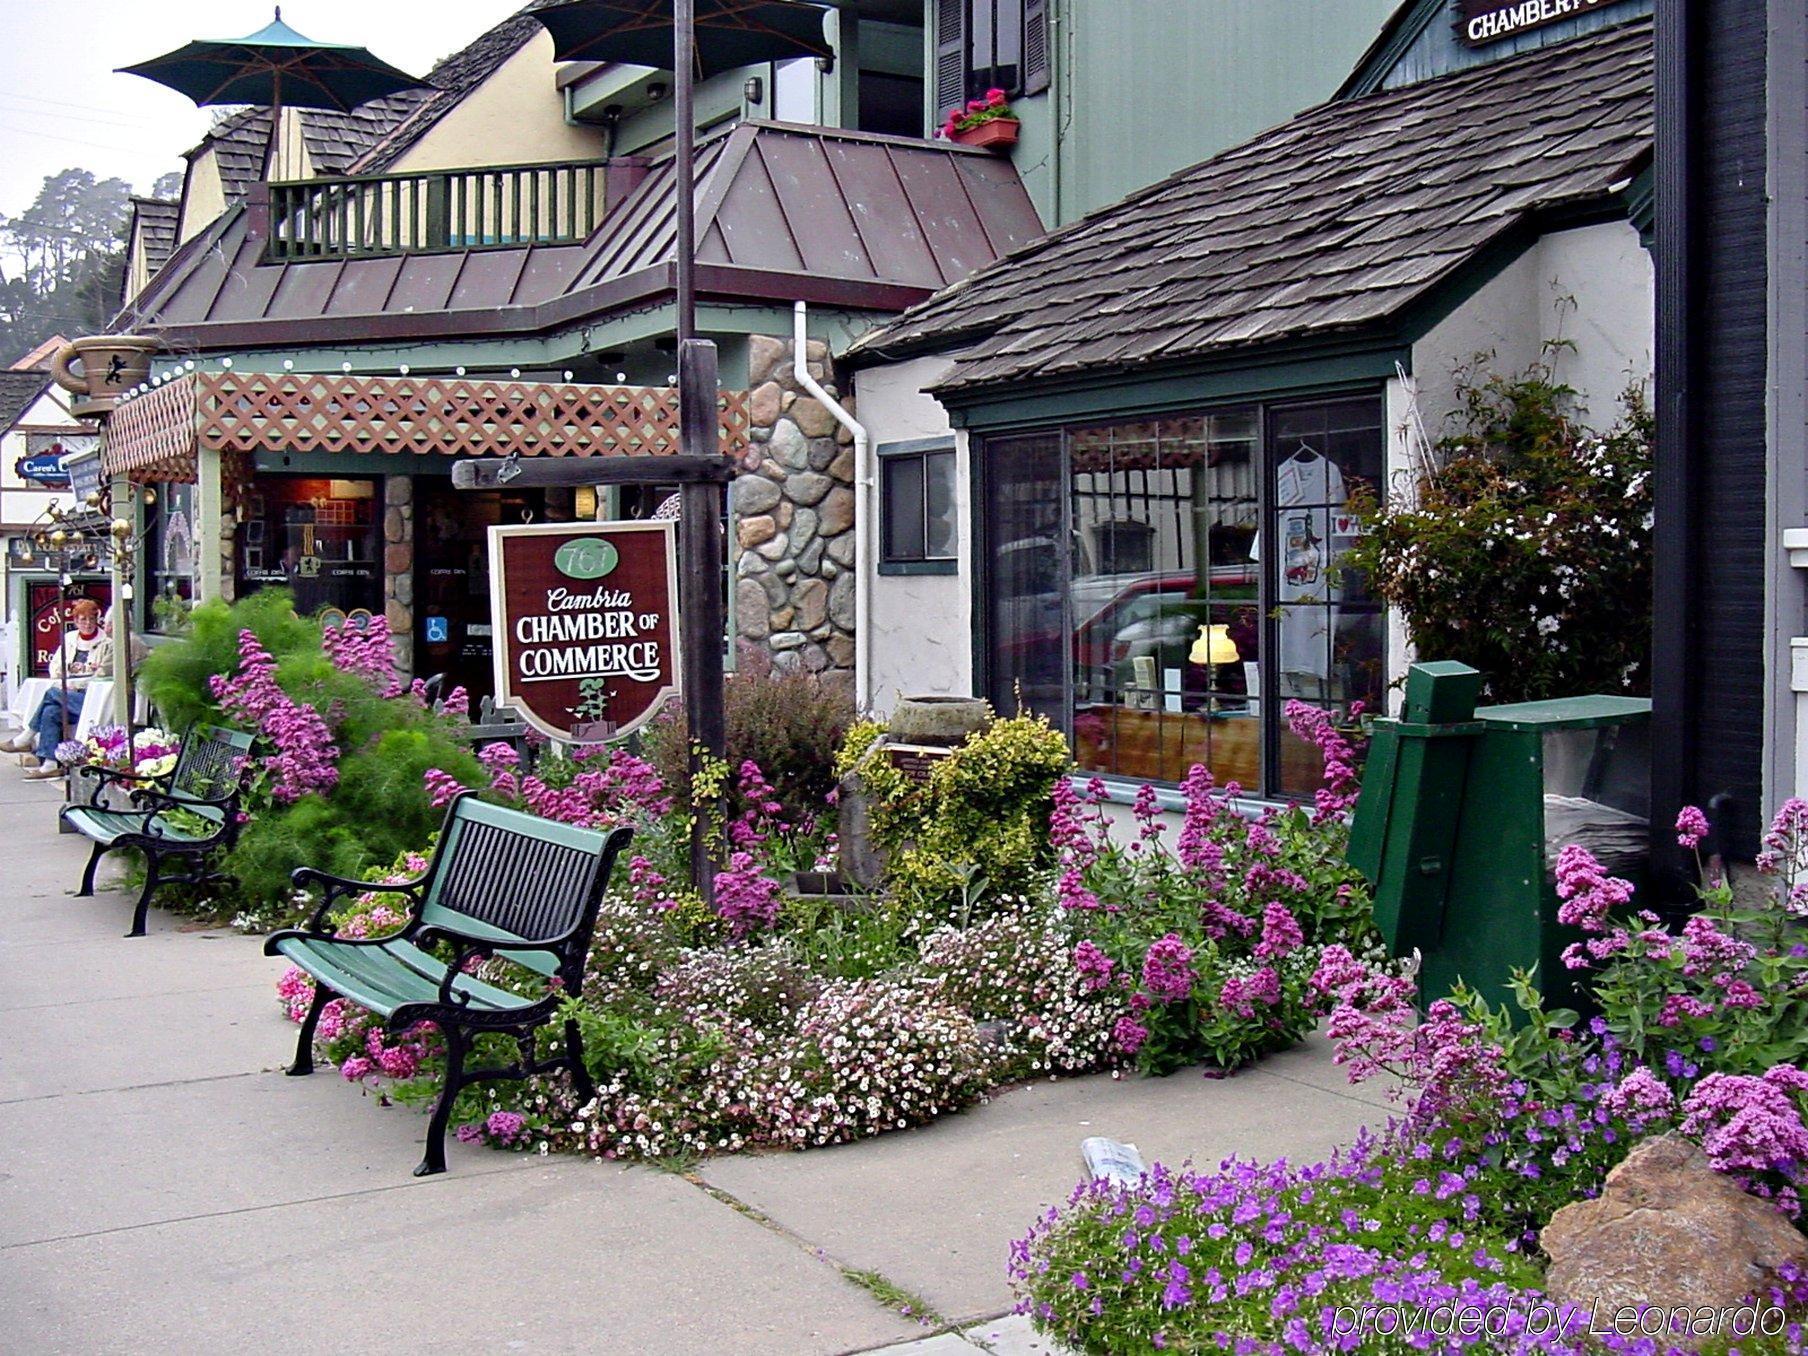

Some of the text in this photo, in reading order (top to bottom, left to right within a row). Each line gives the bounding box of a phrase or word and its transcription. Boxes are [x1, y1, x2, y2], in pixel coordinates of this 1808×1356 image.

[547, 586, 632, 612] Cambria
[516, 611, 660, 644] CHAMBER OF
[519, 642, 660, 680] COMMERCE
